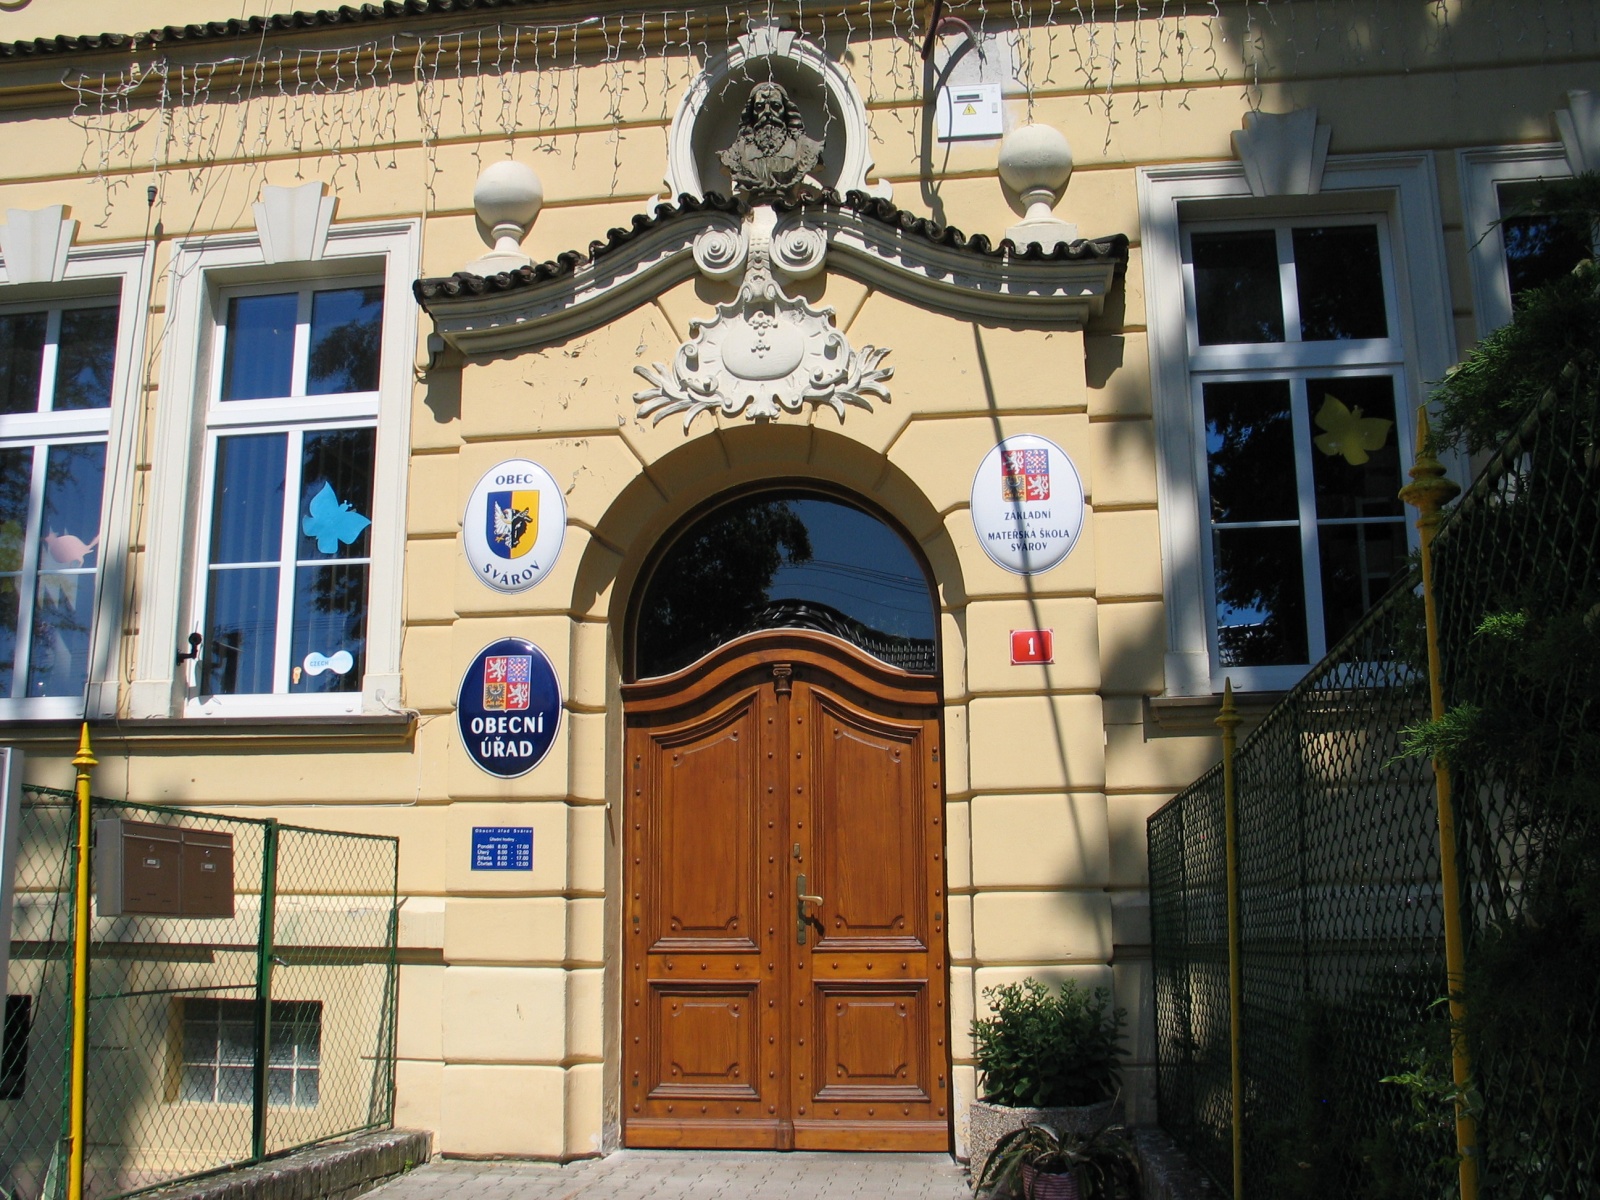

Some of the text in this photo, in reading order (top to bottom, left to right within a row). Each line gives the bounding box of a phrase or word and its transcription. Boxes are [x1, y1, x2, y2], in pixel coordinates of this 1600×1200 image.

[495, 474, 533, 485] OBEC
[1005, 508, 1051, 521] ZÁKLADNÍ
[988, 528, 1070, 540] MATEŘSKÁ ŠKOLA
[1011, 539, 1048, 551] SVÁROV
[483, 560, 540, 585] SVÁROV
[1028, 637, 1035, 655] 1
[471, 712, 543, 734] OBECNÍ
[481, 737, 533, 757] ÚŘAD
